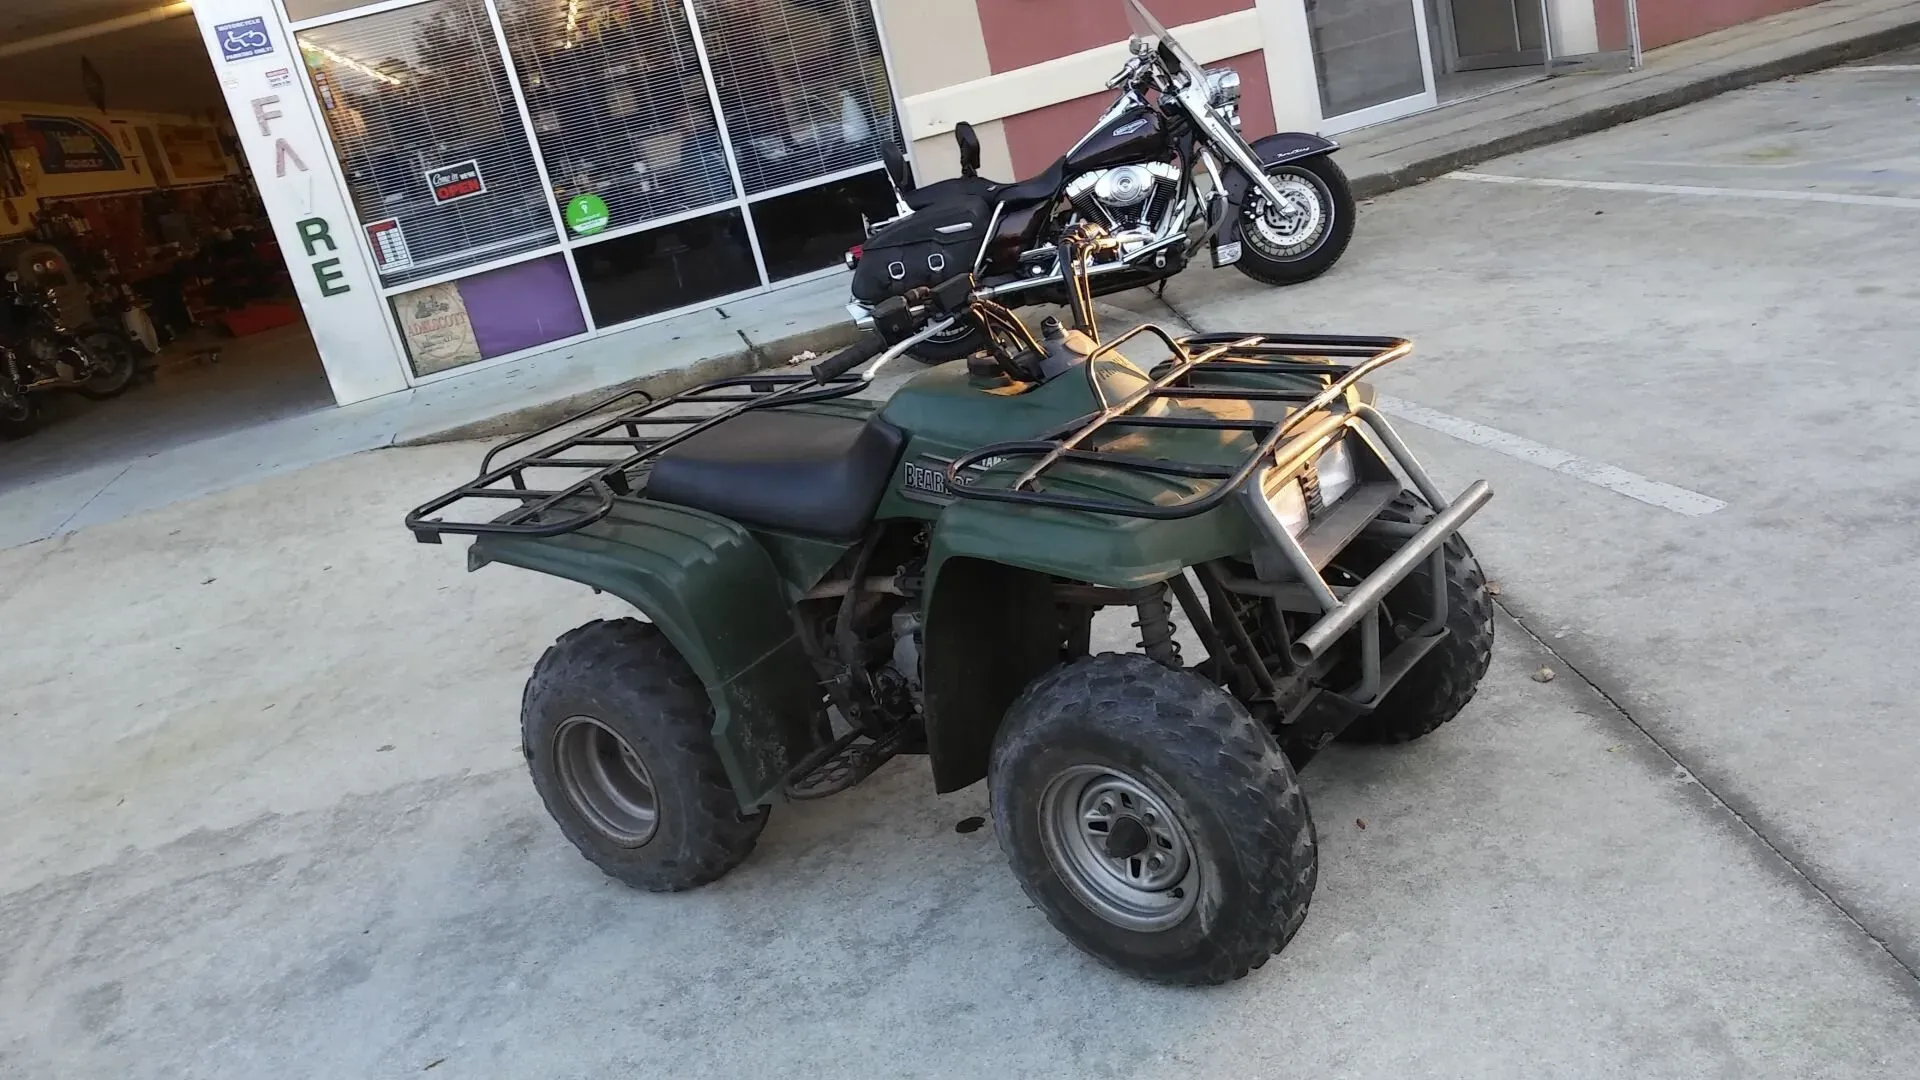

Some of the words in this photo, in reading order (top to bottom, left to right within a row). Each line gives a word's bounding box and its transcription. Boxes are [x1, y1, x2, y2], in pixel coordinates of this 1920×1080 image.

[217, 18, 261, 31] MOTORCYCLE
[225, 50, 254, 60] PARKING
[432, 173, 451, 186] Come
[437, 177, 480, 200] OPEN
